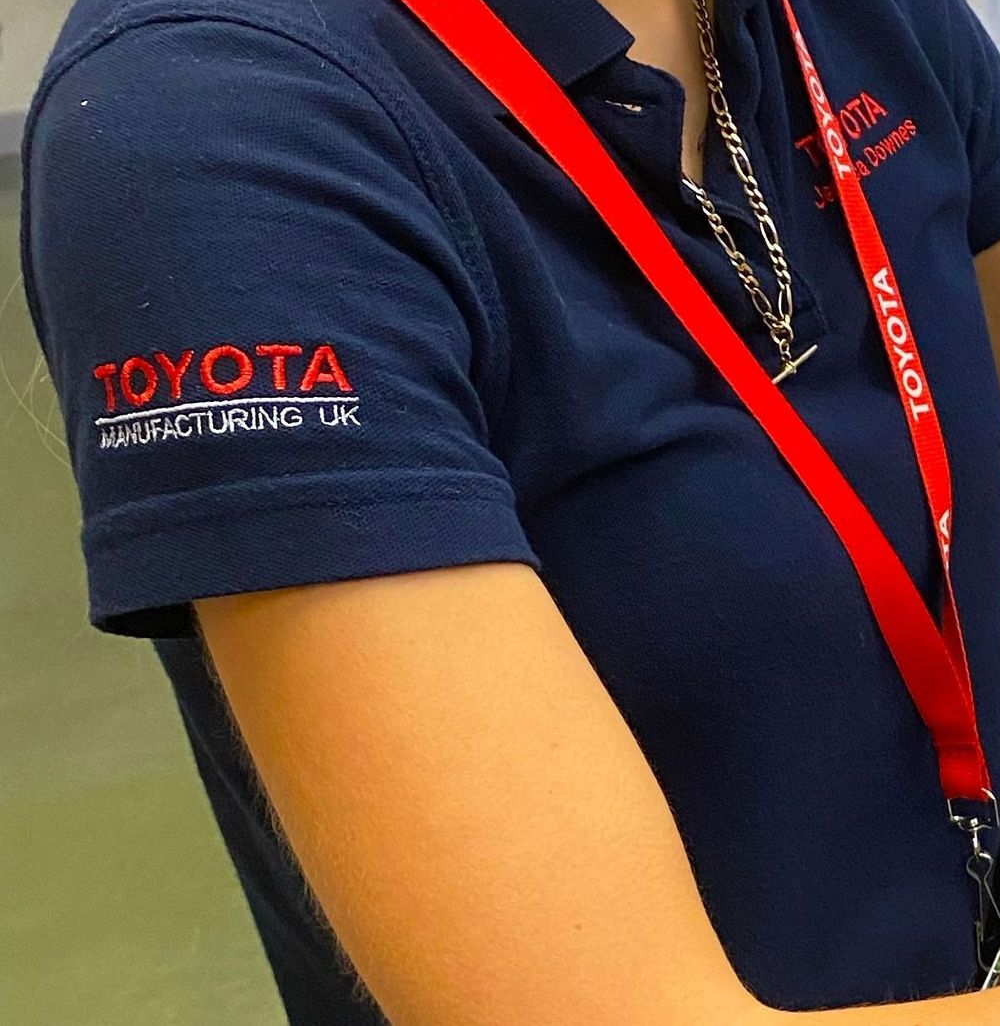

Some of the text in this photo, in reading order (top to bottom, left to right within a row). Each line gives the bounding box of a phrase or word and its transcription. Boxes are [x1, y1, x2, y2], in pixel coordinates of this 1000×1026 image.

[795, 91, 889, 164] TOTA
[863, 119, 917, 167] Downes
[94, 344, 353, 412] TOYOTA
[872, 268, 929, 422] TOYOTA
[99, 405, 361, 449] MANUFACTURING UK
